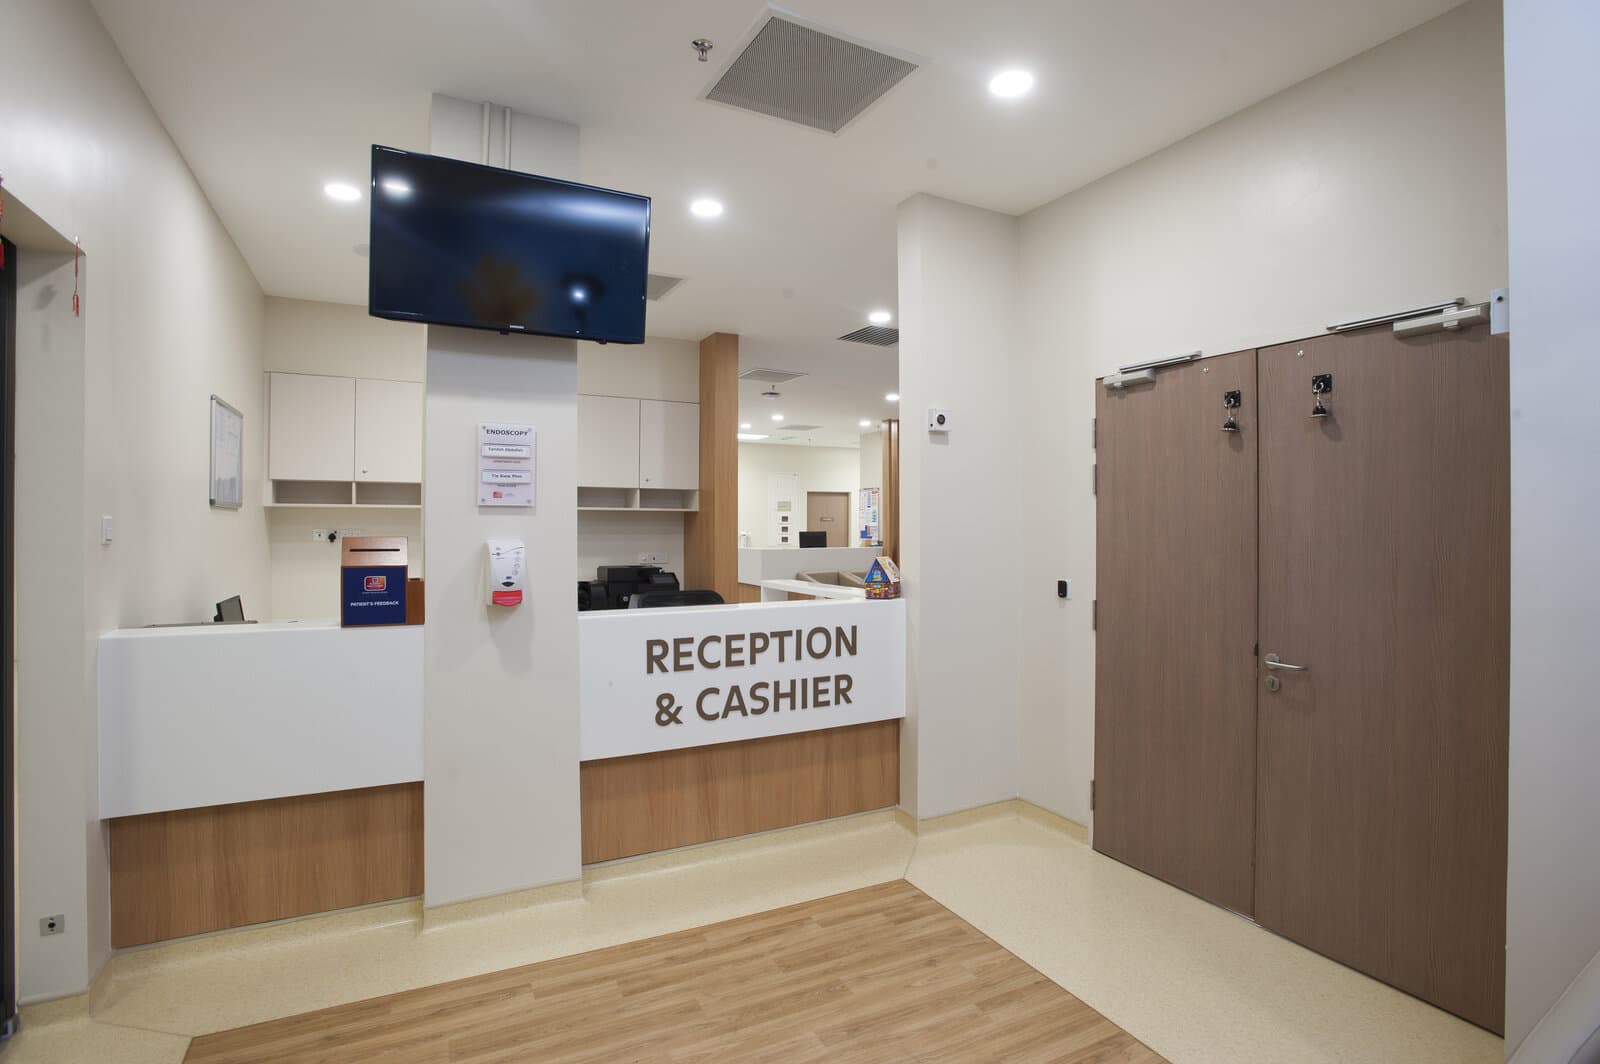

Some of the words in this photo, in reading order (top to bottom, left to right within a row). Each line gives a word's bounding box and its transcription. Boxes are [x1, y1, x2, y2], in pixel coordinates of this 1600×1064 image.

[486, 428, 528, 436] ENDOSCOPY
[646, 625, 857, 674] RECEPTION
[655, 692, 683, 727] &
[696, 674, 853, 721] CASHIER
